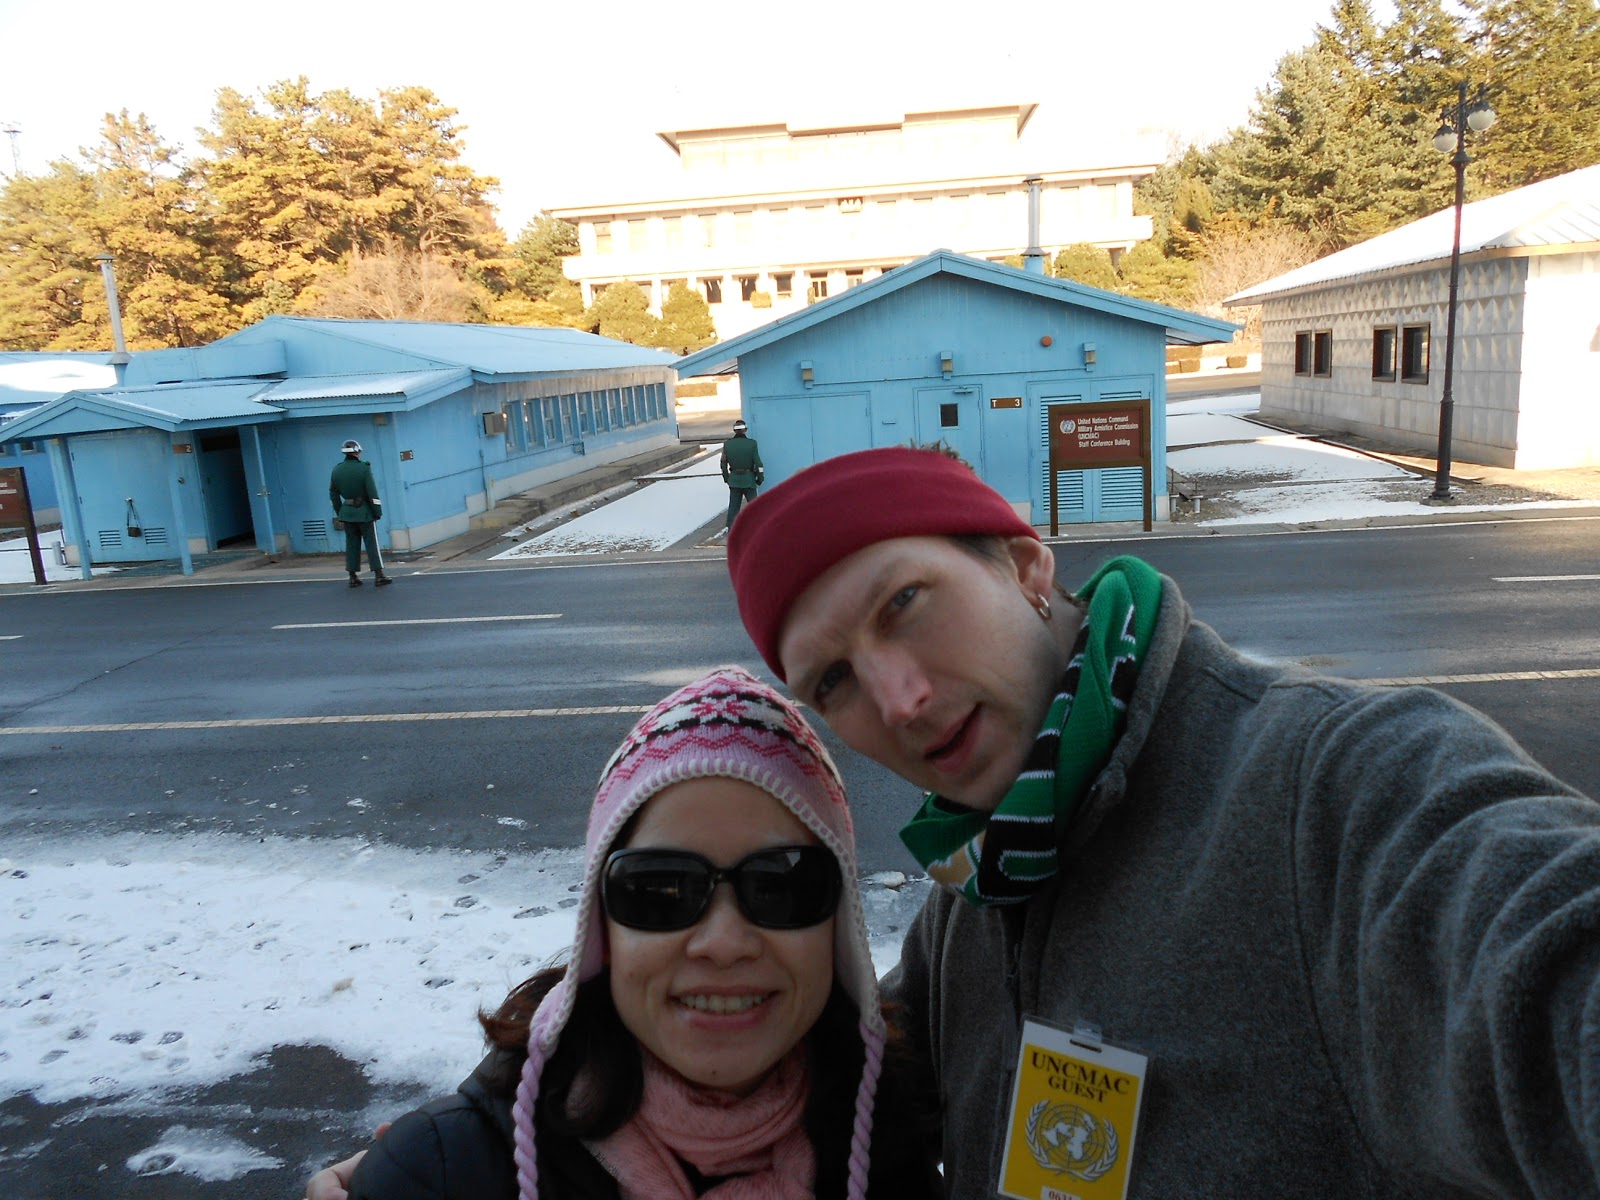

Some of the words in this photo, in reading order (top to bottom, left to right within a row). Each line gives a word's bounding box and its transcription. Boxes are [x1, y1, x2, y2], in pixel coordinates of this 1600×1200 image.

[1014, 399, 1020, 407] 3
[1094, 424, 1113, 432] Armistice
[1078, 432, 1100, 440] (UNCMAC)
[1079, 440, 1089, 448] Staff
[1031, 1051, 1131, 1095] UNCMAC
[1047, 1076, 1109, 1103] GUEST
